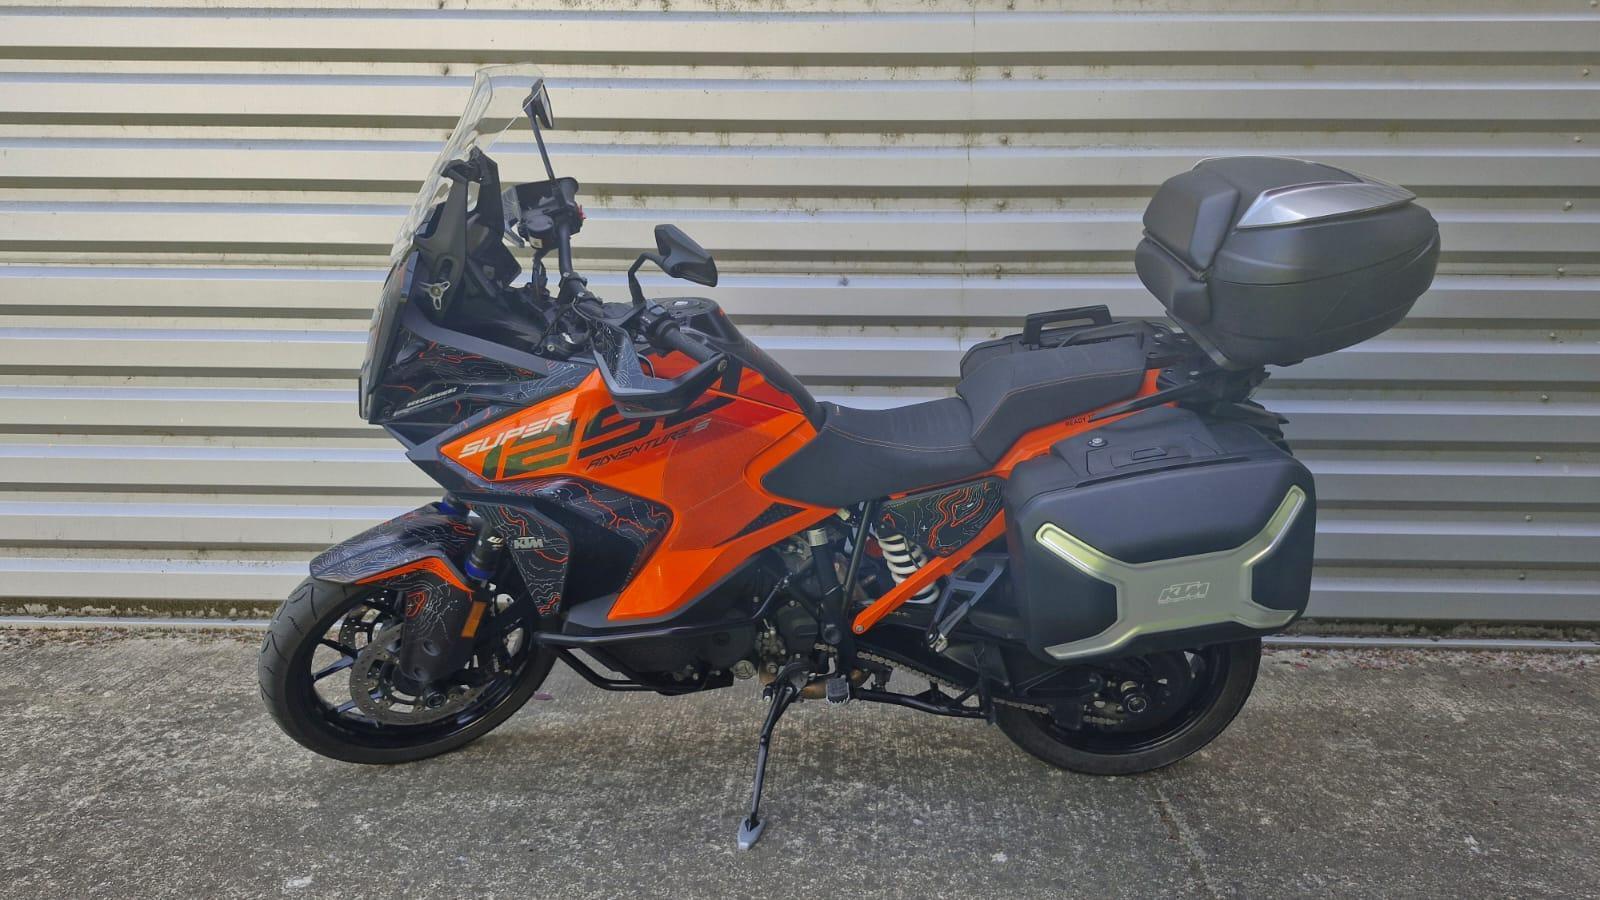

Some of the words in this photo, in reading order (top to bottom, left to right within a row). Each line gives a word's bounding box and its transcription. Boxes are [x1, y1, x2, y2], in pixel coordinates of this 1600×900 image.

[458, 410, 572, 458] SUPER
[585, 427, 690, 471] ADVENTURE
[692, 418, 712, 433] S
[513, 536, 544, 550] KTM
[1158, 581, 1211, 604] KTM
